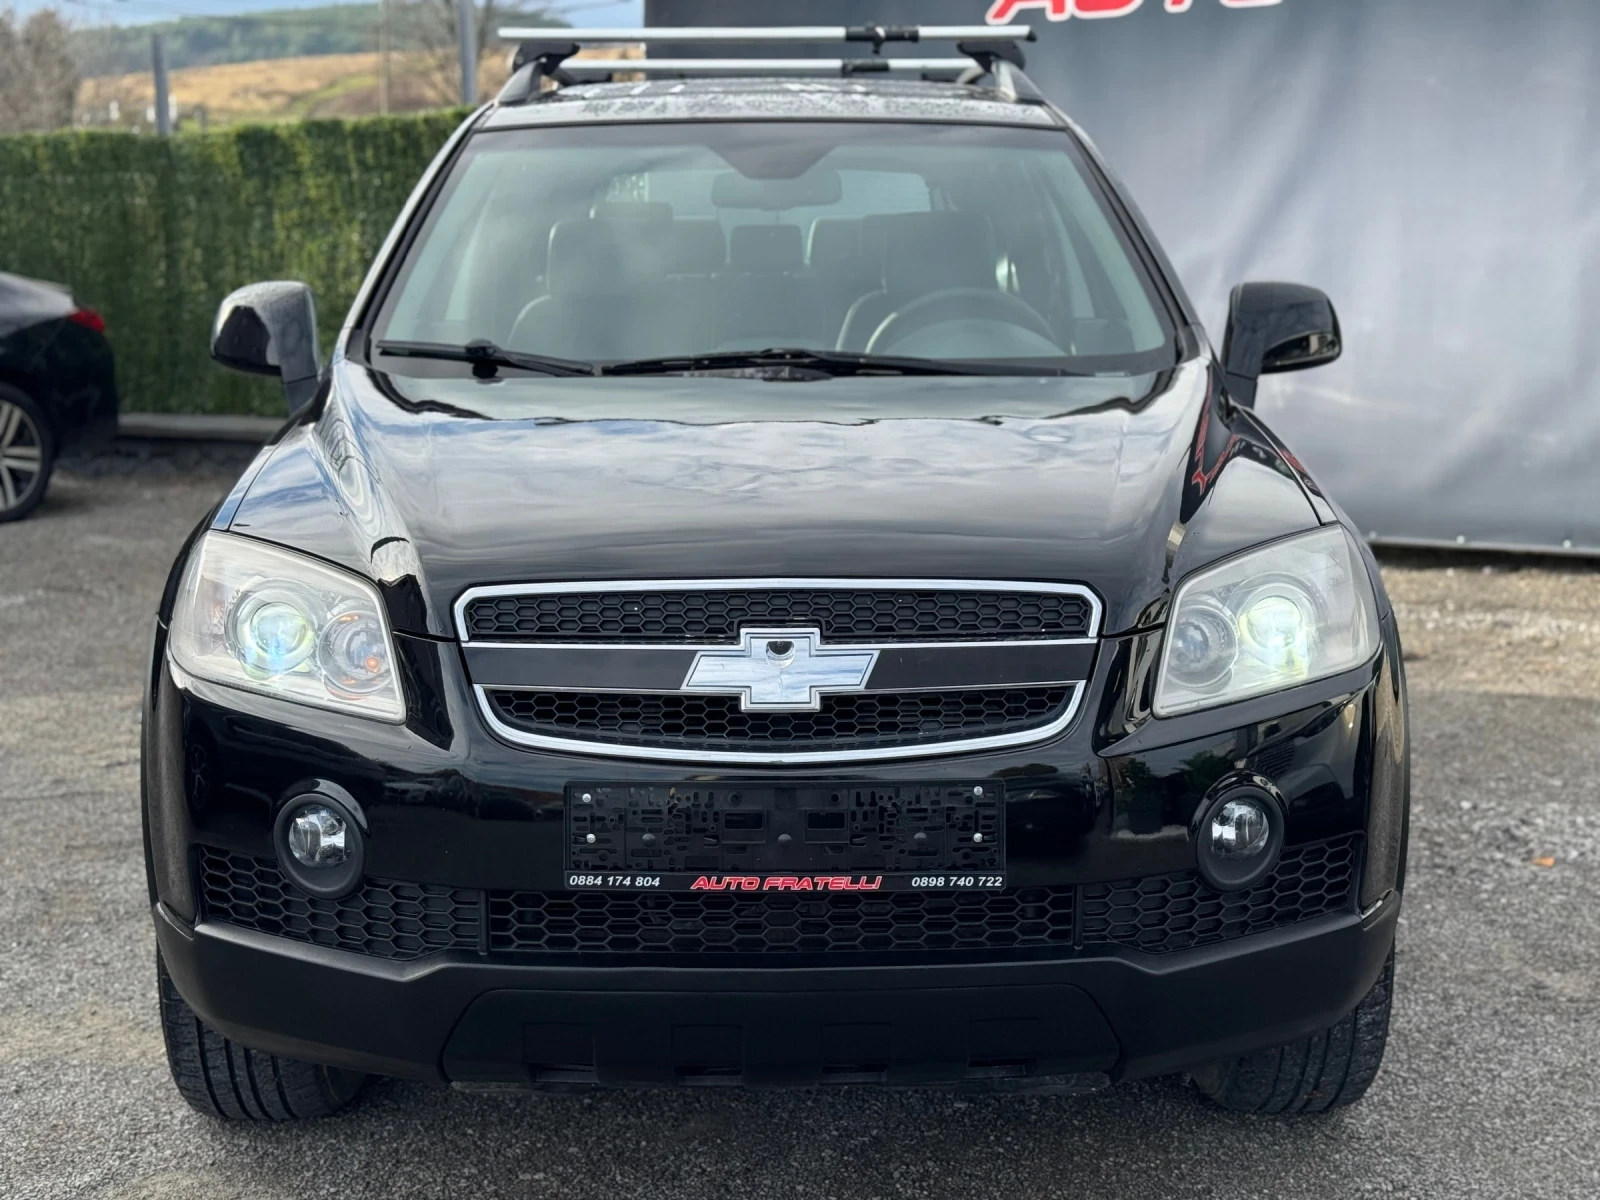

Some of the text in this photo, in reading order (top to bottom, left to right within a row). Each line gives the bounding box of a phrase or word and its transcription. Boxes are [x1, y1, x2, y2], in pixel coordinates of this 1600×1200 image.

[569, 875, 661, 887] 0884 174 804
[690, 876, 883, 891] AUTO FRATELLI
[911, 876, 1003, 887] 0898 740 722
